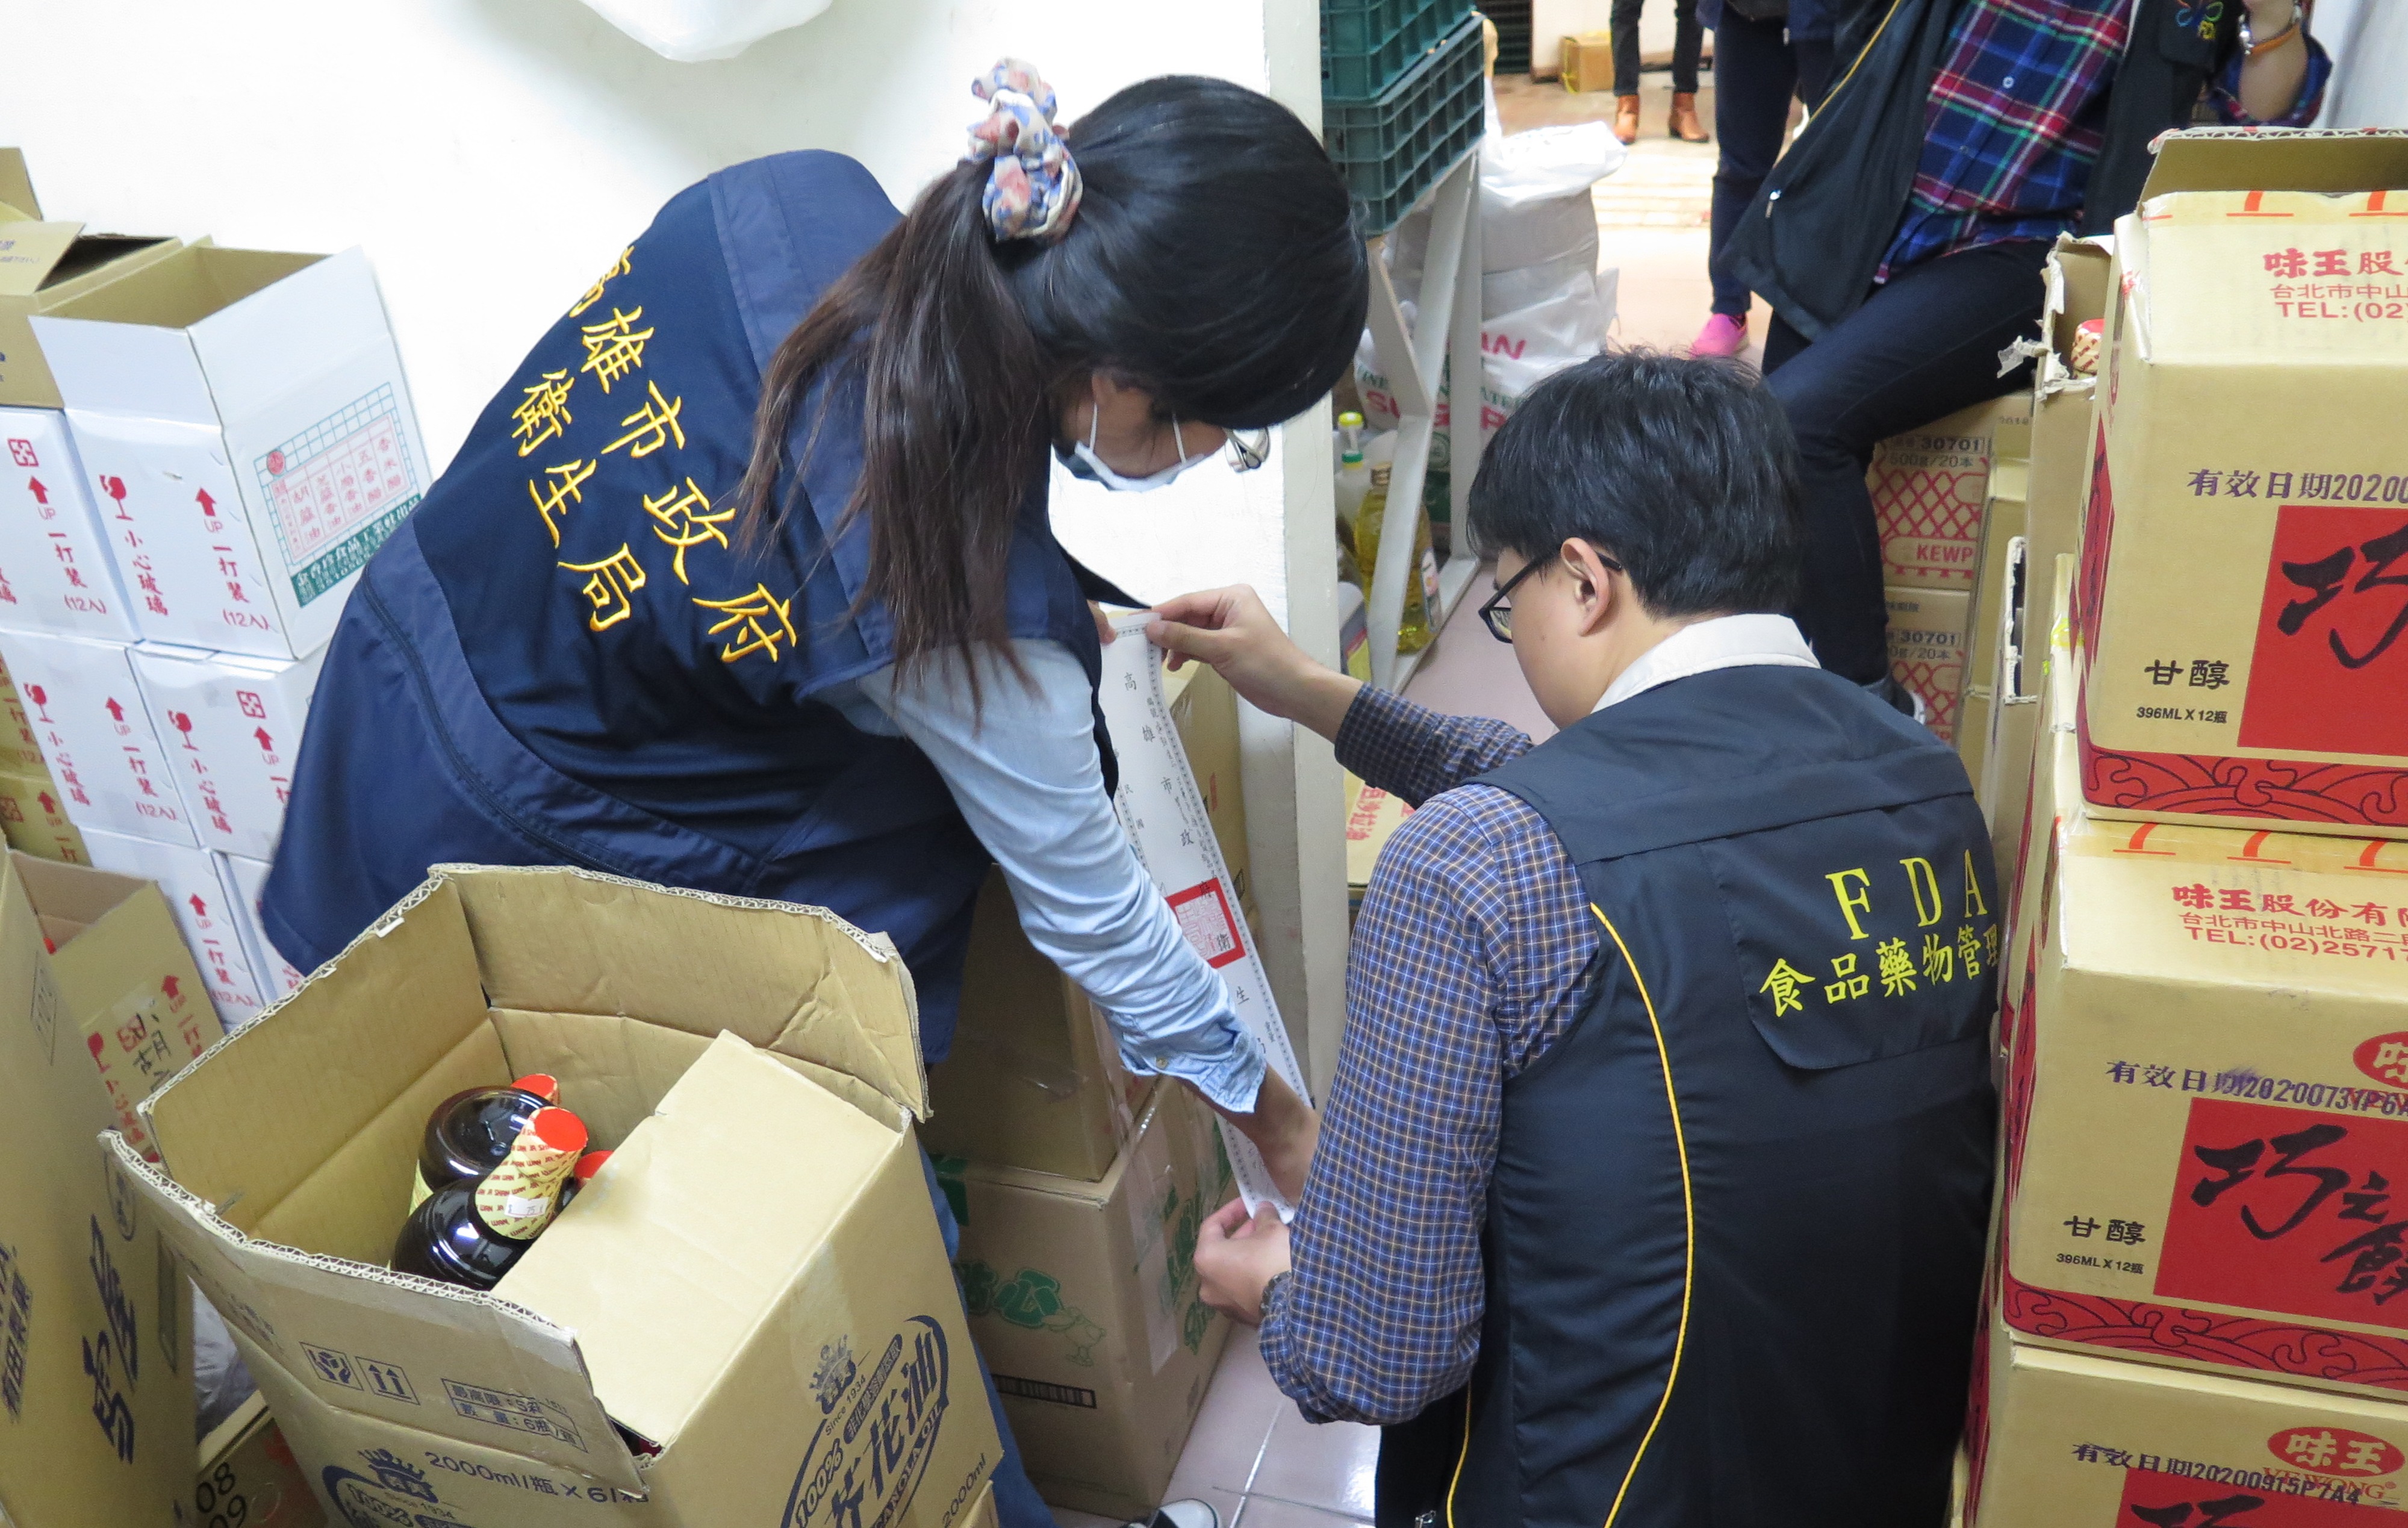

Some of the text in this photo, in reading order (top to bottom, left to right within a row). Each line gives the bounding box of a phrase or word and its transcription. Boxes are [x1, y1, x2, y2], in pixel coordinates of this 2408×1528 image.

[2263, 248, 2408, 278] 味王股
[2270, 284, 2408, 299] 台北市中山
[2276, 301, 2408, 323] TEL:(02
[38, 507, 57, 520] UP
[512, 367, 646, 632] 衛生局
[203, 519, 224, 534] UP
[48, 532, 89, 590] 一打裝
[124, 530, 169, 617] 小心玻璃
[212, 544, 251, 604] 一打裝
[2144, 659, 2231, 690] 甘醇
[2136, 706, 2183, 721] 396ML
[2179, 912, 2408, 946] 台北市中山北路二
[2064, 1214, 2147, 1246] 甘醇
[2056, 1252, 2102, 1269] 396ML
[845, 1374, 866, 1405] 1934
[2285, 1430, 2387, 1475] 味王
[196, 1461, 235, 1514] 08
